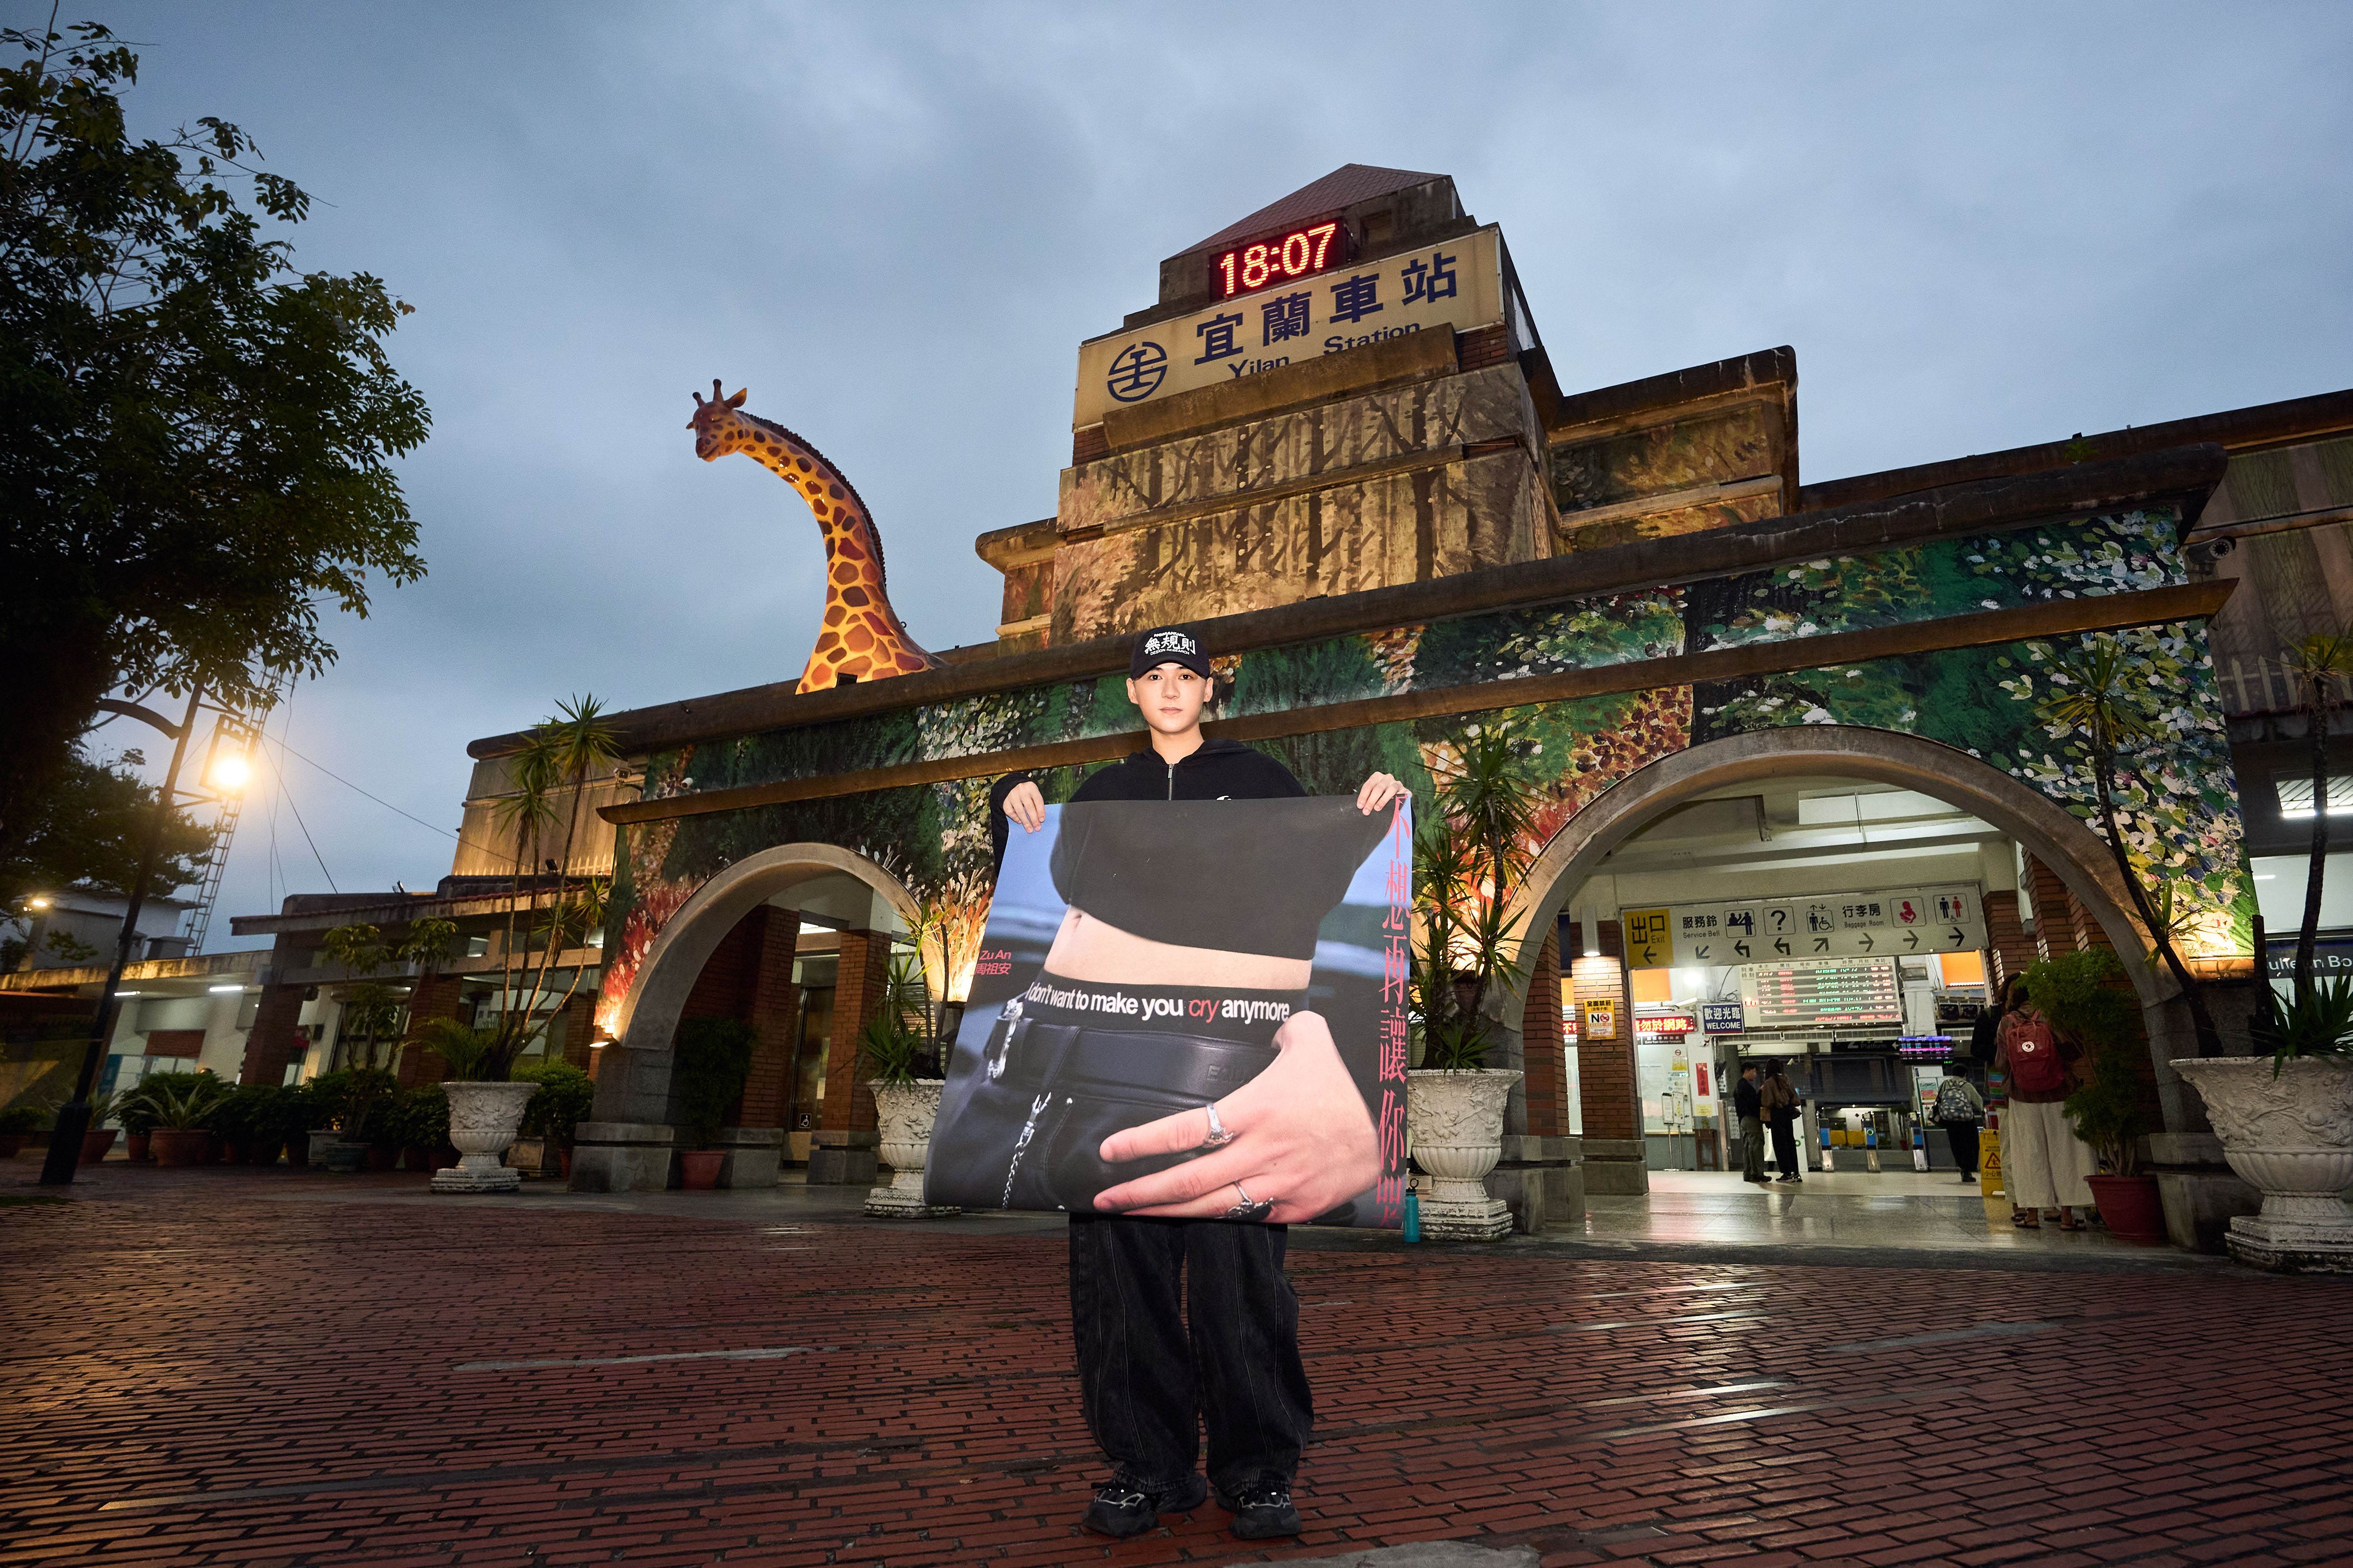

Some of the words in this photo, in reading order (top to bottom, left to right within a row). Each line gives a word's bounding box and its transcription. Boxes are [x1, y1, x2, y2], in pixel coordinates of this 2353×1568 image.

[1220, 223, 1335, 295] 18:07
[1194, 252, 1457, 366] 宜蘭車站
[1228, 356, 1289, 377] Yilan
[1323, 322, 1420, 355] Station
[1144, 635, 1196, 655] 無規則
[1842, 903, 1881, 918] 行李房
[1631, 915, 1665, 944] 出口
[1683, 915, 1717, 929] 服務鈴
[1651, 935, 1665, 944] Exit
[979, 950, 994, 960] Zu
[994, 949, 1011, 960] An
[974, 963, 1011, 975] 周祖安
[1025, 981, 1035, 999] I
[1028, 982, 1052, 1005] don't
[1050, 989, 1076, 1009] want
[1074, 989, 1089, 1010] to
[1090, 992, 1139, 1015] make
[1141, 998, 1184, 1021] you
[1188, 999, 1219, 1023] cry
[1222, 999, 1289, 1024] anymore
[1704, 1007, 1740, 1020] 歡迎光臨
